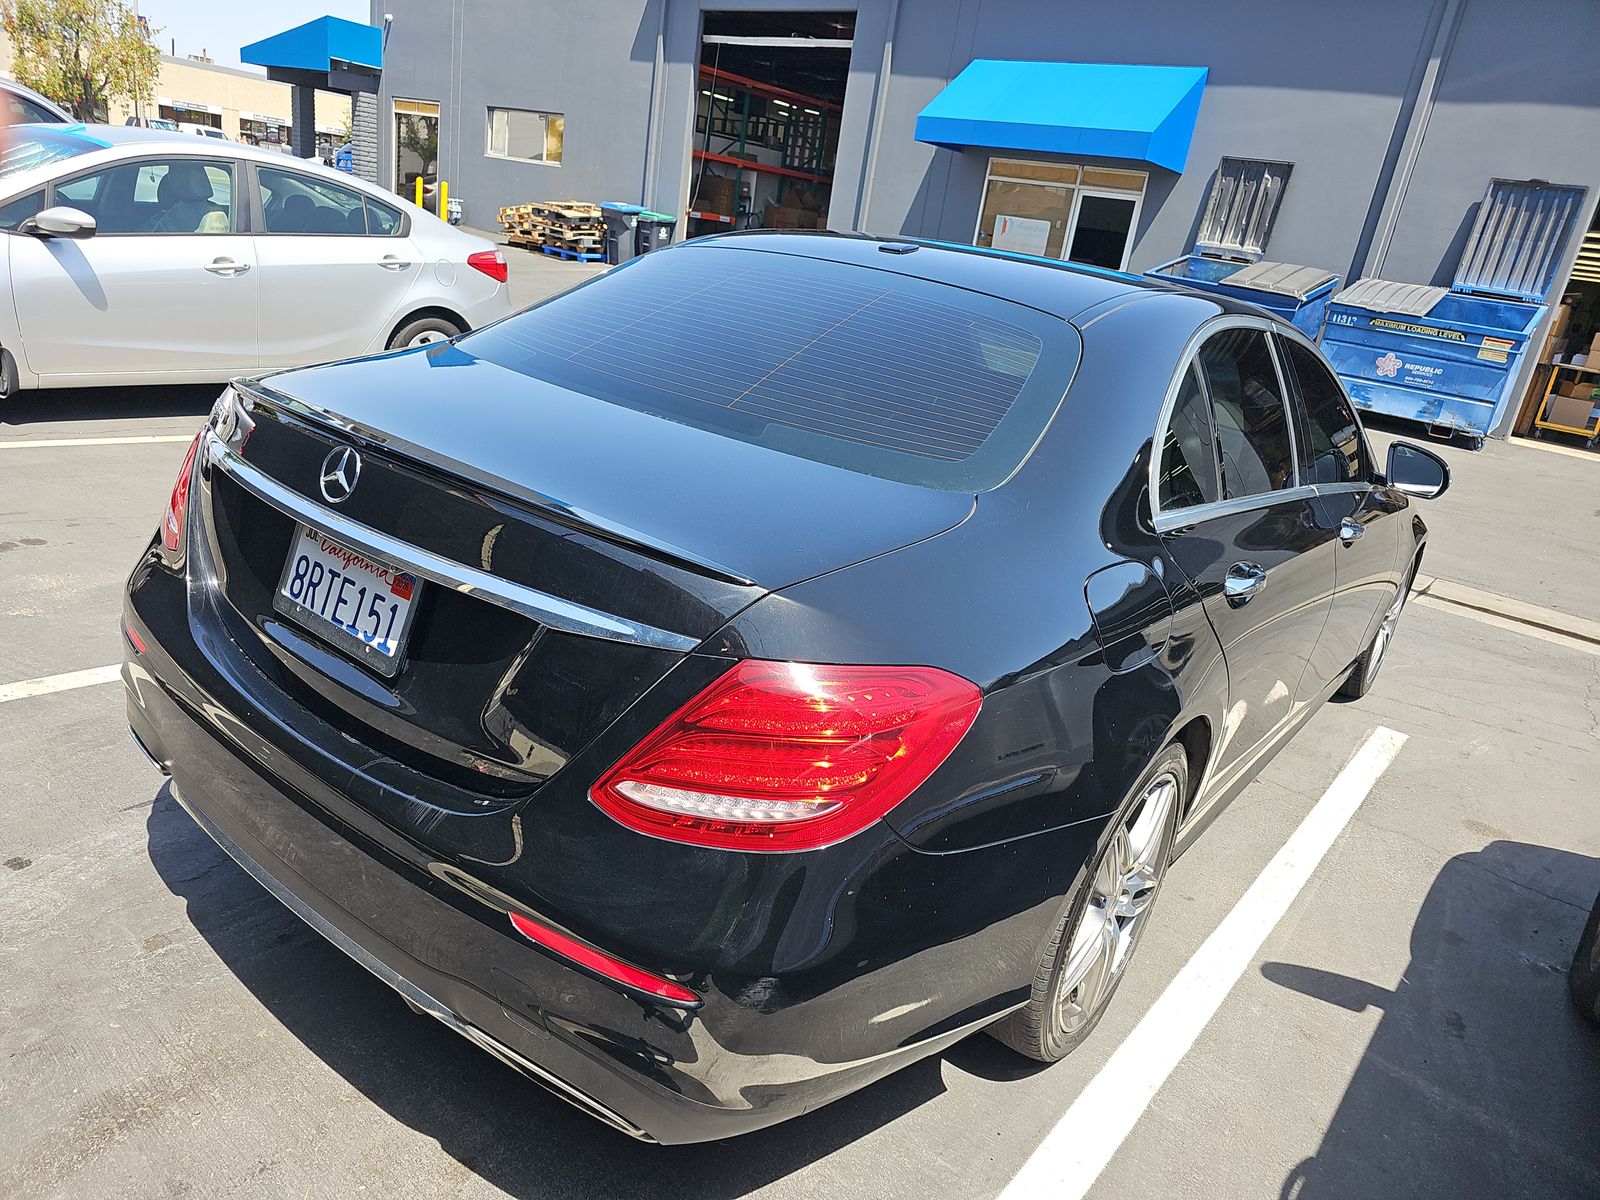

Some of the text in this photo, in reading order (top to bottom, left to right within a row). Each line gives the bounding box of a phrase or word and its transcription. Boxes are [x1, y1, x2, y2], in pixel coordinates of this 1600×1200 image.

[1374, 320, 1461, 341] MAXIMUM LOADING LEVEL
[1404, 363, 1443, 375] REPUBLIC
[289, 554, 399, 655] 8RTE151
